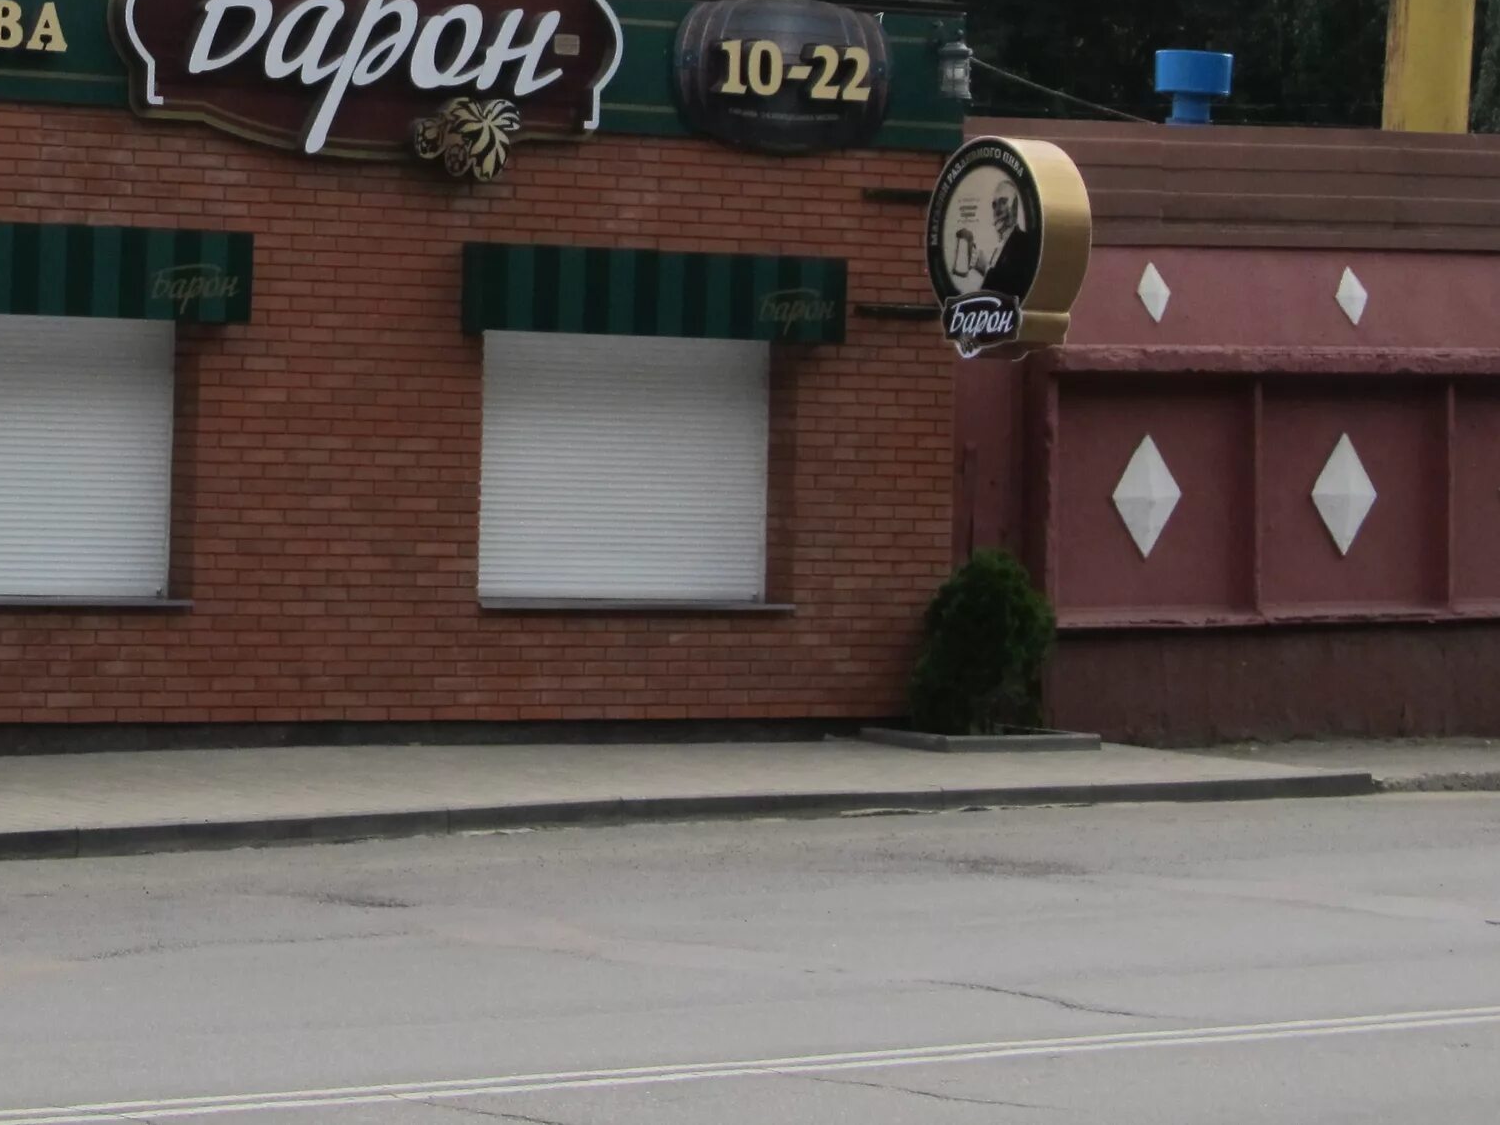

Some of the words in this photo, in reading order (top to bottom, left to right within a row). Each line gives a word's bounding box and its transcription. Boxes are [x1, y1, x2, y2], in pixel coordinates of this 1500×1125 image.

[720, 39, 871, 102] 10-22
[150, 263, 241, 316] Барон
[757, 287, 837, 337] Барон
[949, 296, 1014, 338] Барон
